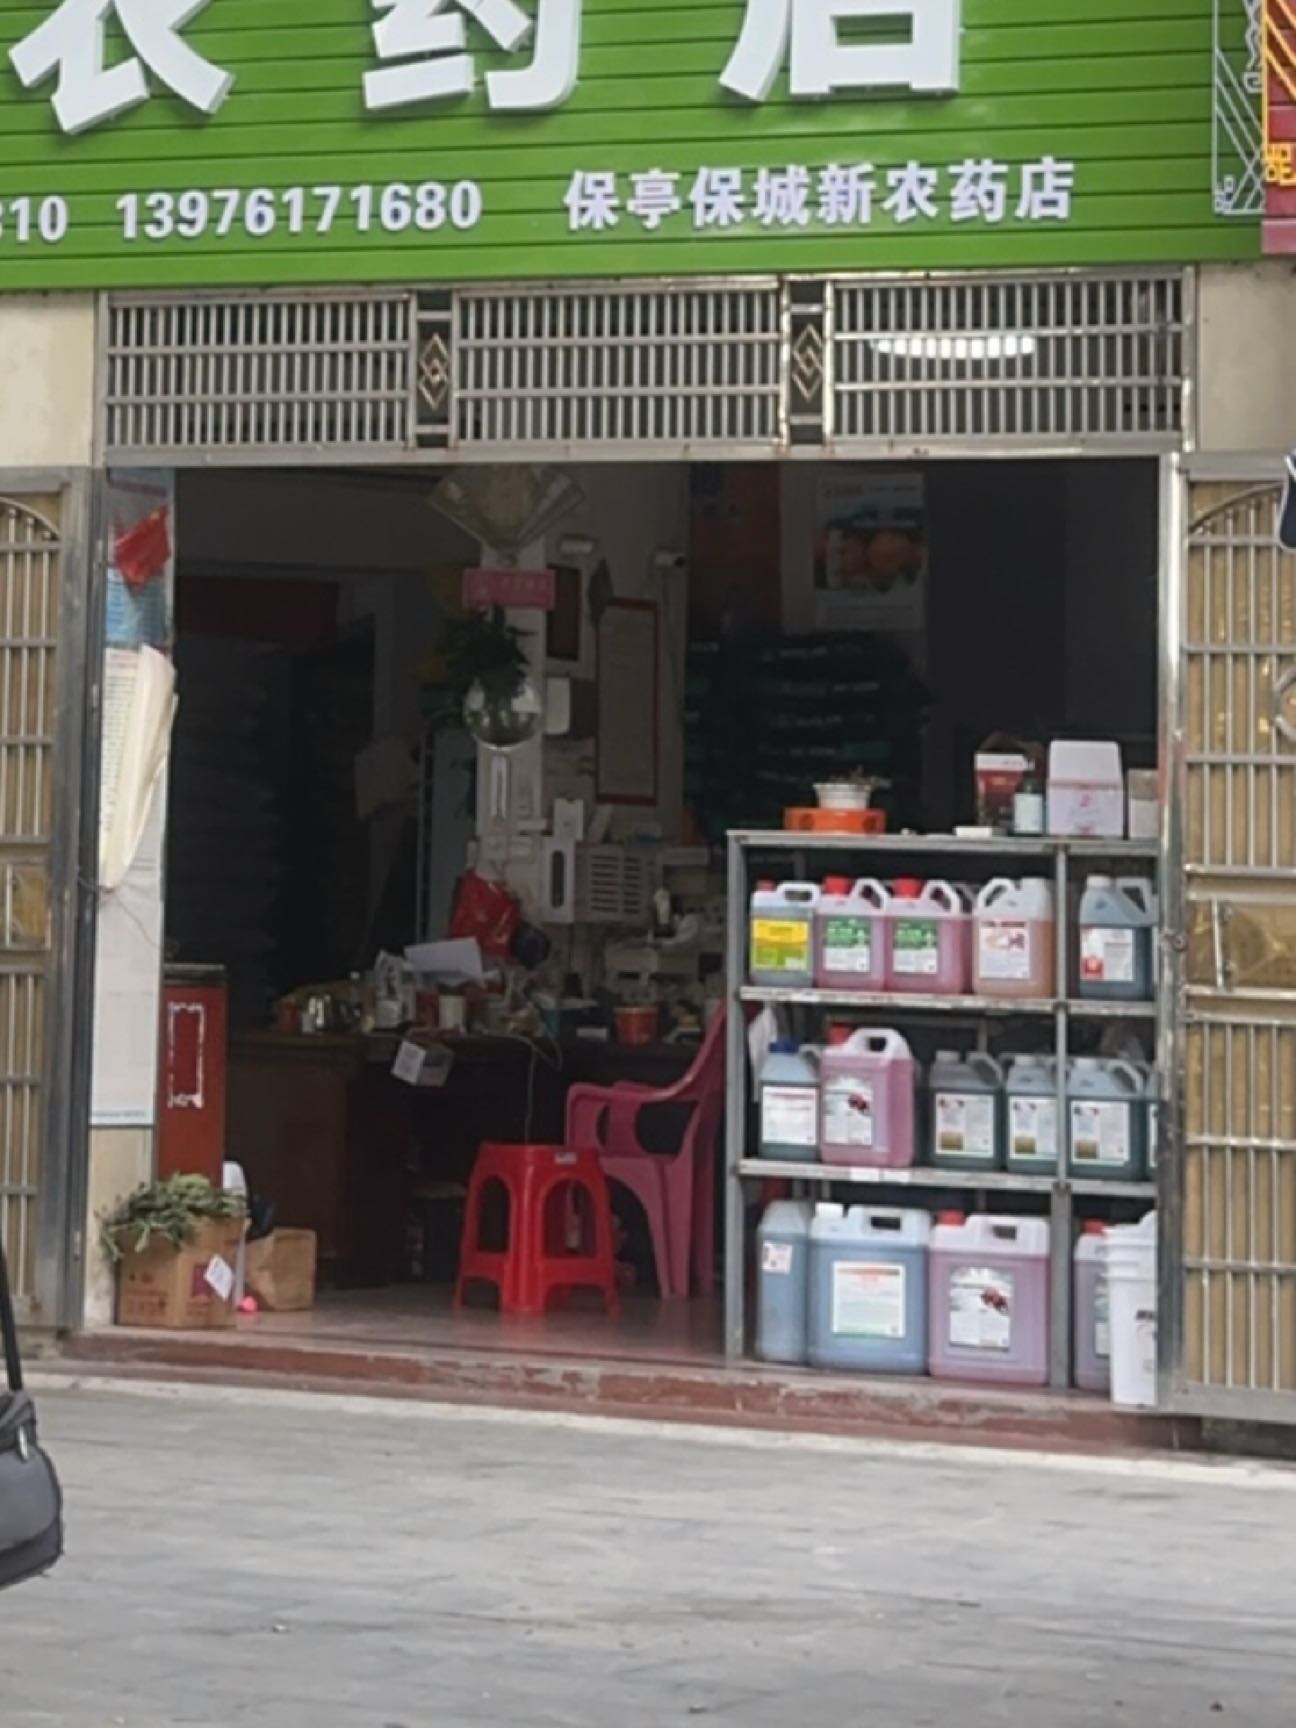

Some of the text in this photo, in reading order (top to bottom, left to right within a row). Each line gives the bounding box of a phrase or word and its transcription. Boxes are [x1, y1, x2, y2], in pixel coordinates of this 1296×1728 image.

[116, 180, 483, 239] 13976171680
[563, 155, 1075, 235] 保亭保城新农药店
